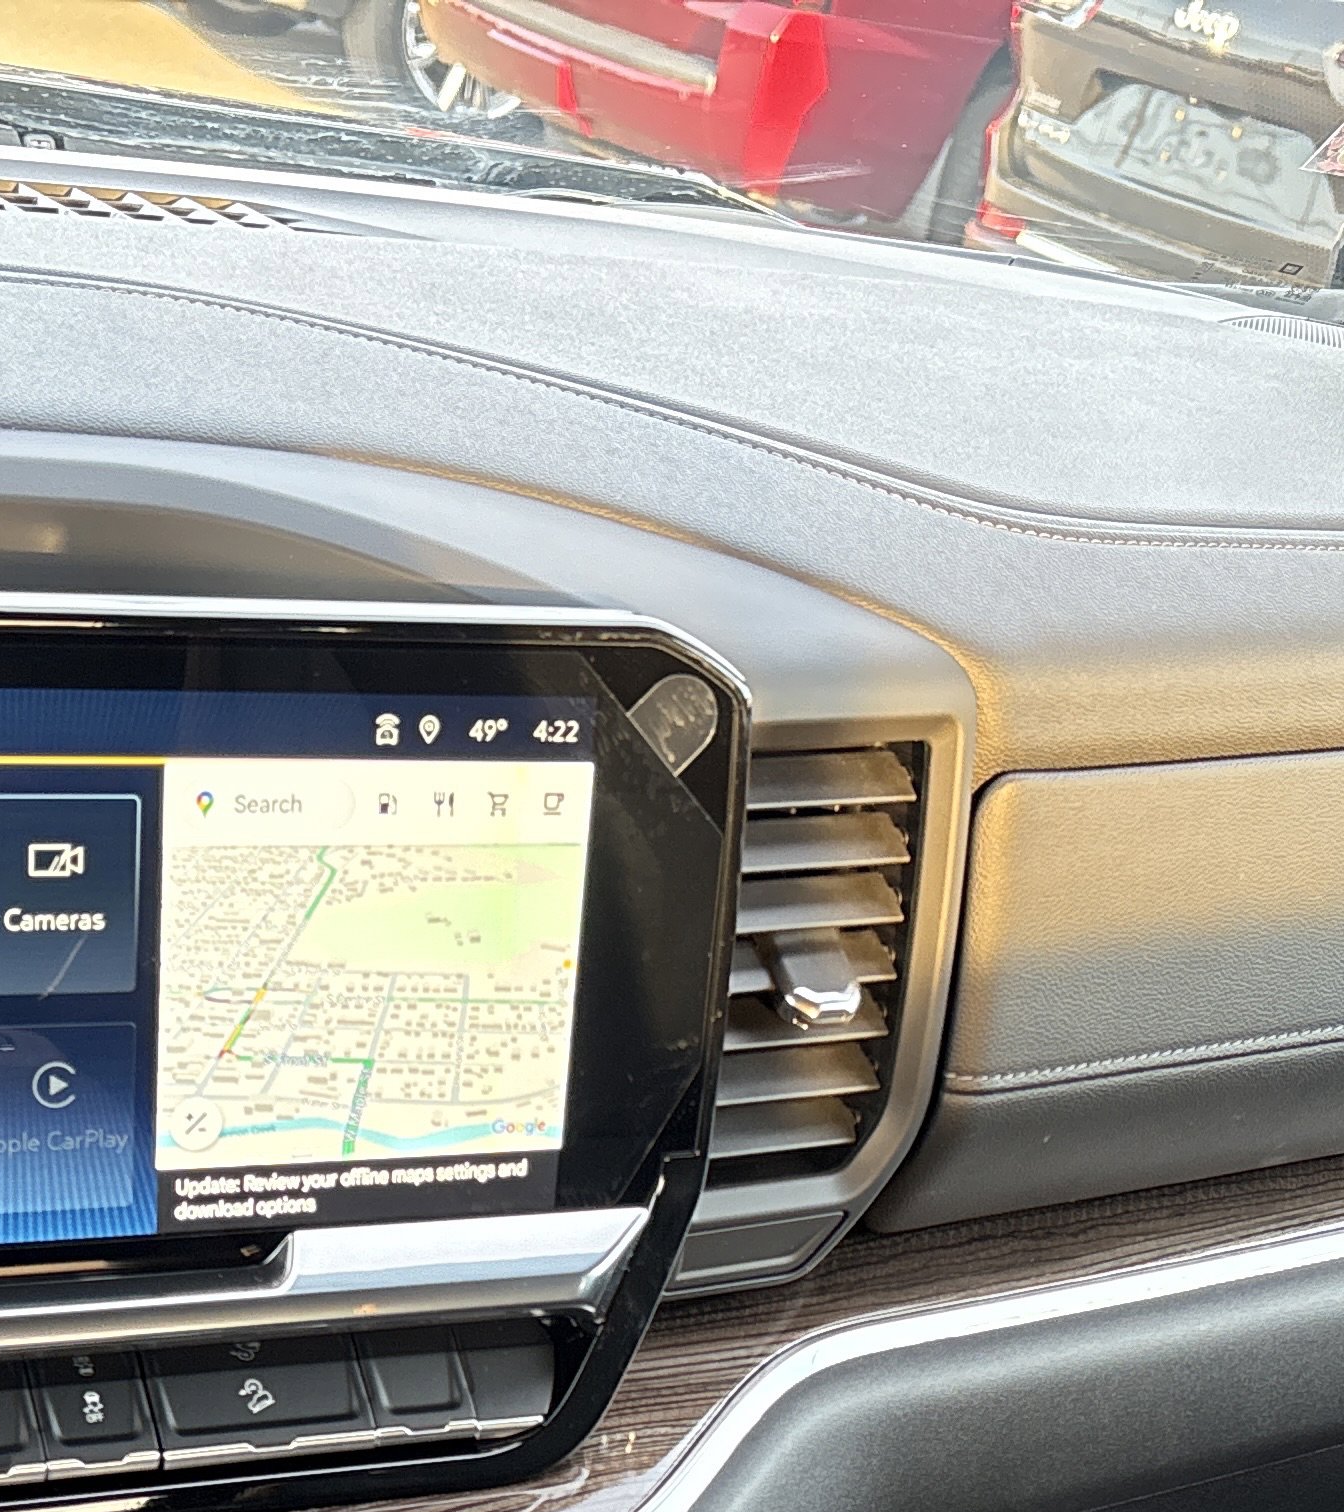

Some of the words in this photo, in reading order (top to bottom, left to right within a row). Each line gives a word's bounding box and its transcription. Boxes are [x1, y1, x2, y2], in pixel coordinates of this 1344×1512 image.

[469, 718, 509, 742] 49°
[533, 719, 580, 743] 4:22
[234, 792, 302, 816] Search
[3, 906, 107, 933] Cameras
[490, 1116, 547, 1137] Google
[46, 1128, 130, 1154] CarPlay
[174, 1174, 242, 1199] Update:
[243, 1171, 300, 1194] Review
[301, 1170, 339, 1193] your
[339, 1166, 389, 1188] offline
[391, 1164, 434, 1187] maps
[435, 1160, 496, 1184] settings
[497, 1158, 529, 1178] and
[174, 1196, 255, 1221] download
[255, 1194, 318, 1218] options
